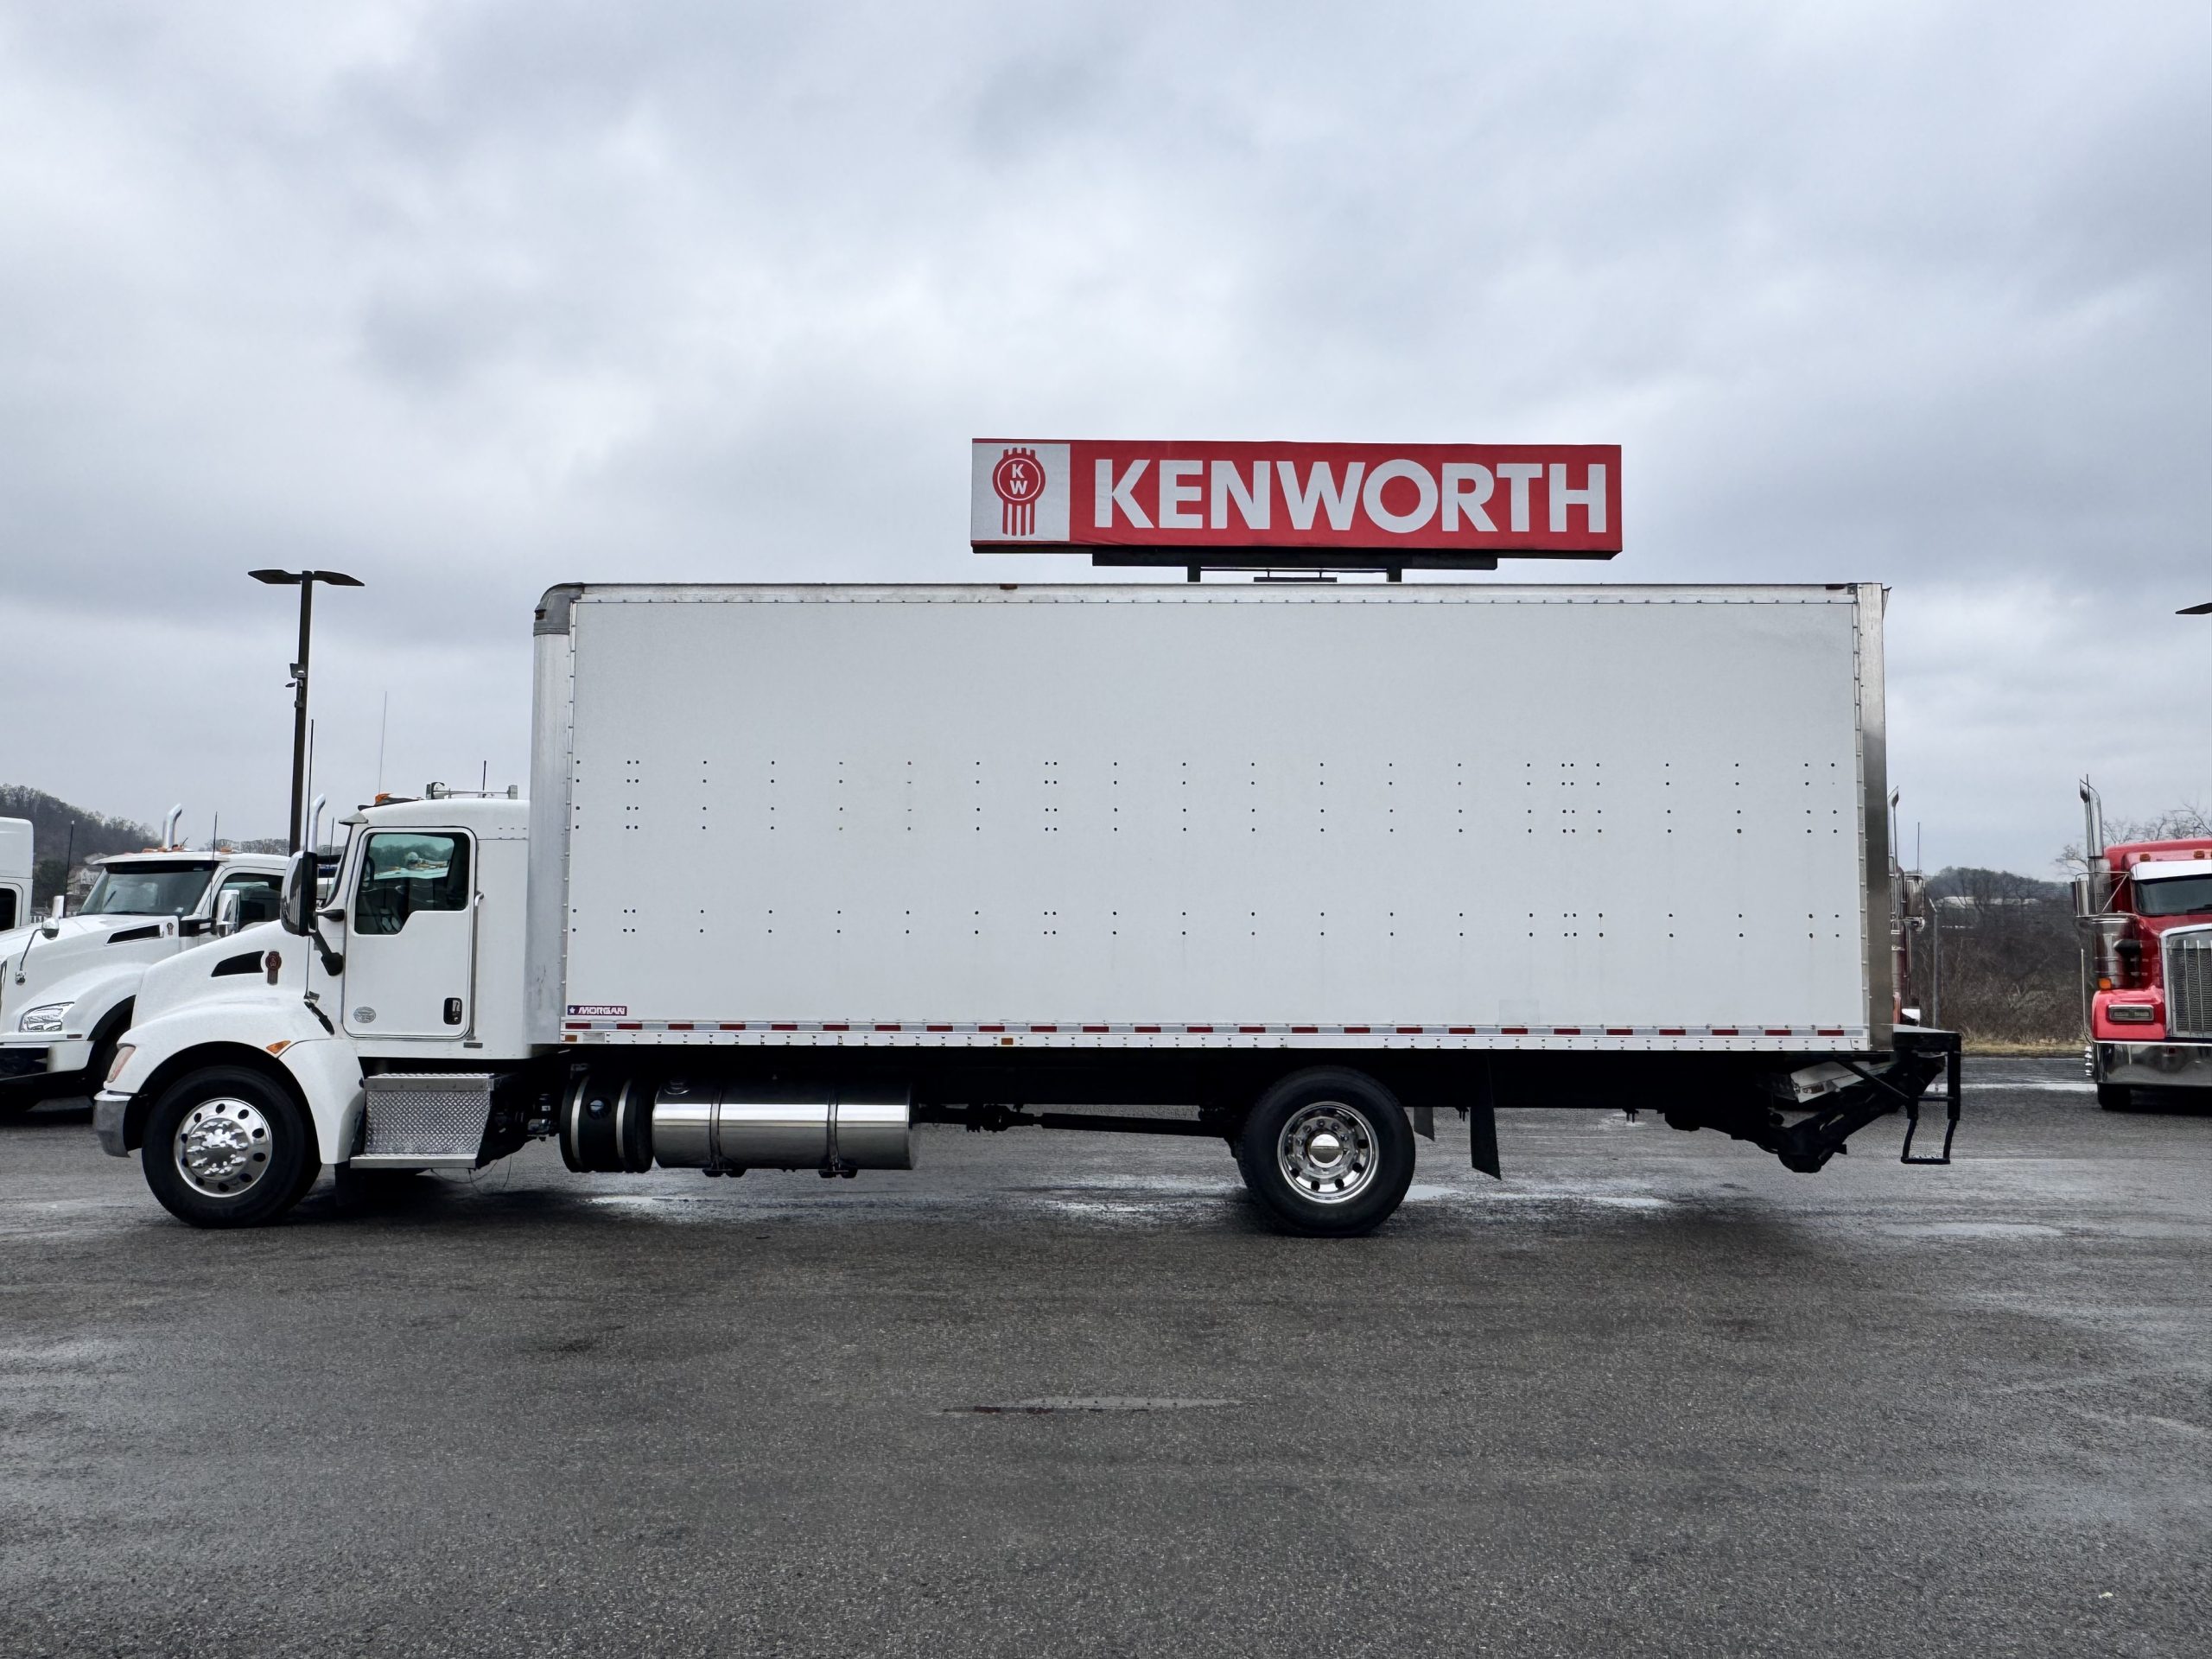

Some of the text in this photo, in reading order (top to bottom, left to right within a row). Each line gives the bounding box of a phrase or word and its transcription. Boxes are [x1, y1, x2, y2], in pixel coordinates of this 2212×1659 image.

[1012, 463, 1025, 478] K
[1009, 480, 1028, 494] W
[1094, 458, 1607, 533] KENWORTH
[578, 1006, 626, 1014] MORGAN
